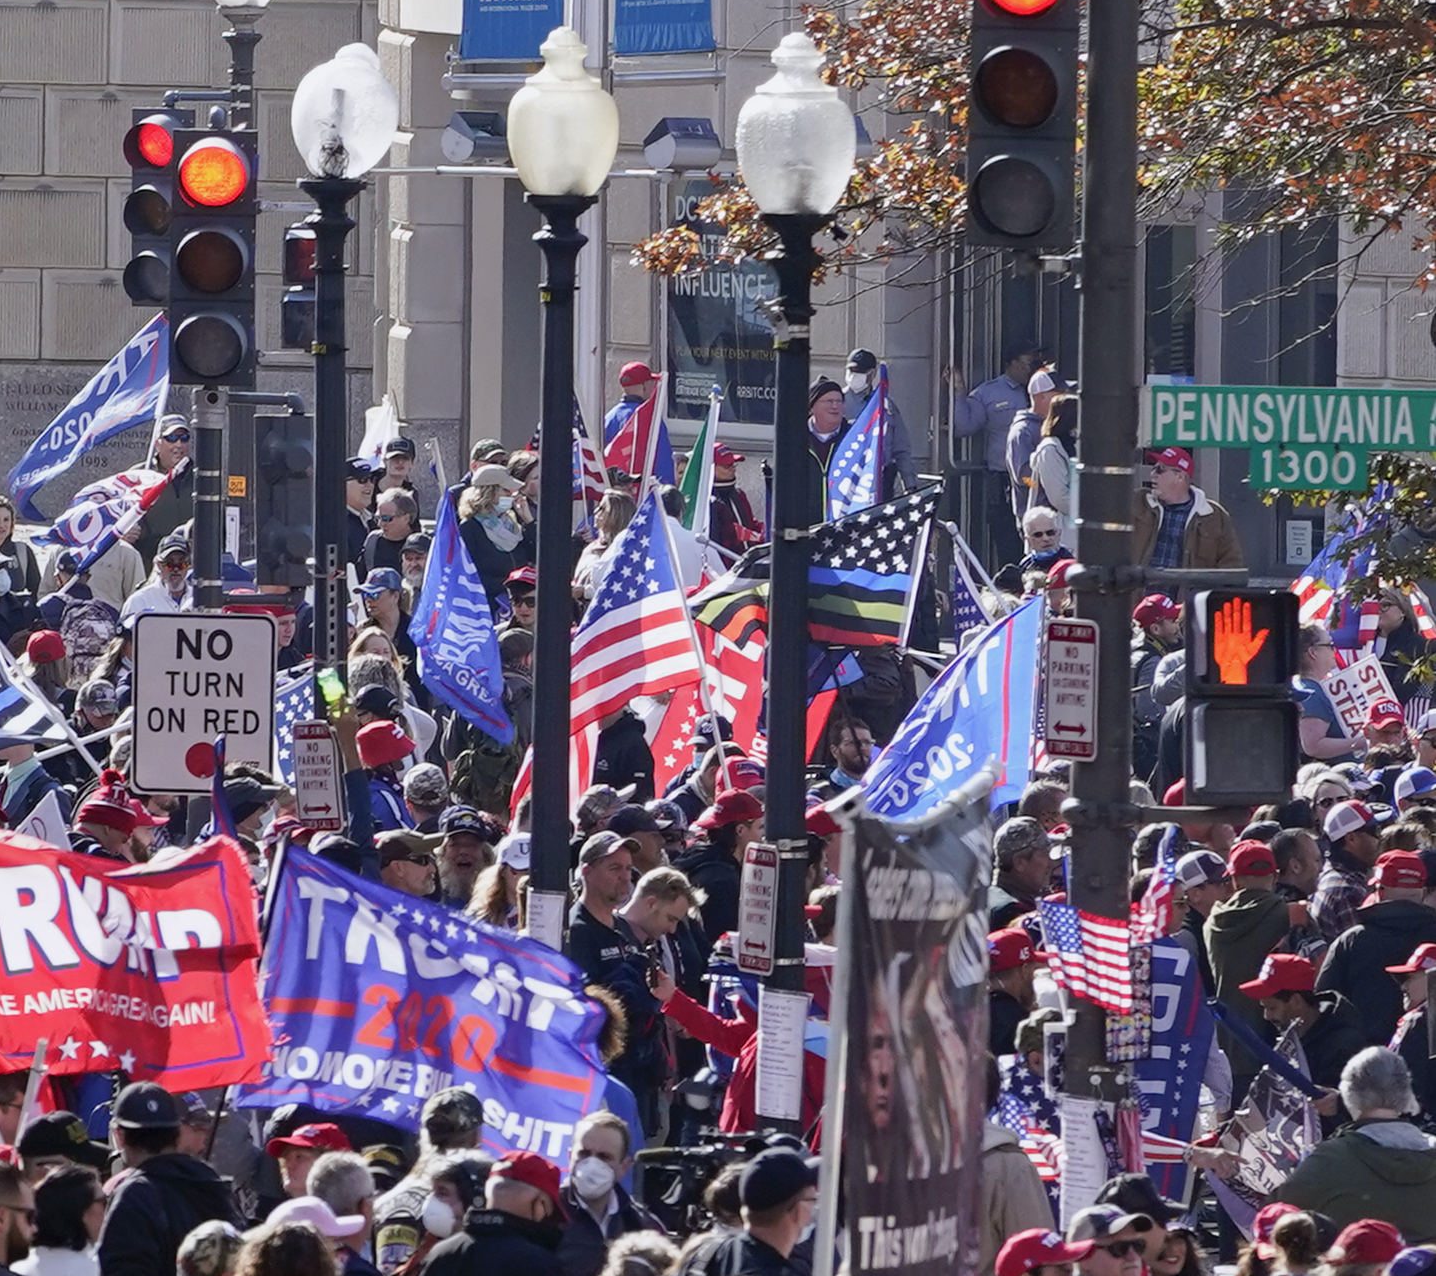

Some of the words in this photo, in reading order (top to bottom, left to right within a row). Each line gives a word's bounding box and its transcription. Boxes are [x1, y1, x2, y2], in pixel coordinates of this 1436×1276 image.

[675, 274, 767, 299] INFLUENCE
[1154, 391, 1415, 445] PENNSYLVANIA
[1261, 449, 1356, 485] 1300
[175, 628, 233, 661] NO
[1063, 646, 1079, 660] NO
[1051, 661, 1091, 676] PARKING
[165, 671, 243, 698] TURN
[147, 707, 185, 733] ON
[203, 708, 260, 735] RED
[1377, 702, 1401, 714] USA
[297, 754, 332, 766] PARKING
[306, 742, 319, 753] NO
[357, 984, 498, 1074] 2020
[259, 1045, 316, 1083] NO
[858, 1215, 906, 1271] This
